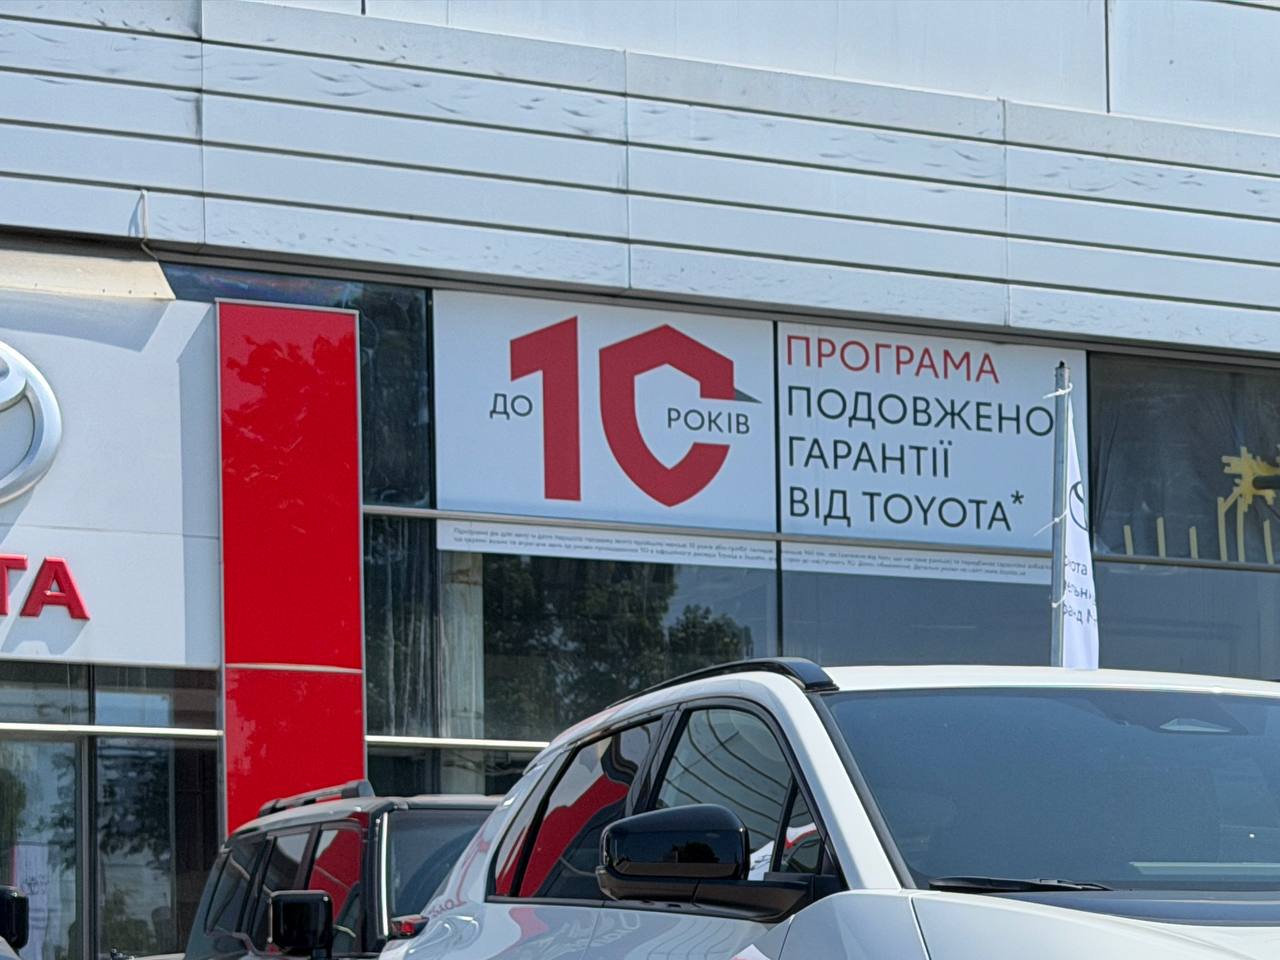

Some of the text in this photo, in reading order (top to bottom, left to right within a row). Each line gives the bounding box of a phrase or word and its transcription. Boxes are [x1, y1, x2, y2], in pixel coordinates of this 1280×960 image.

[786, 334, 1000, 384] ПРОГРАМА
[489, 393, 534, 420] ДО
[666, 407, 751, 435] РОКІВ
[788, 436, 953, 479] ГАРАНТІЇ
[789, 486, 852, 528] ВІД
